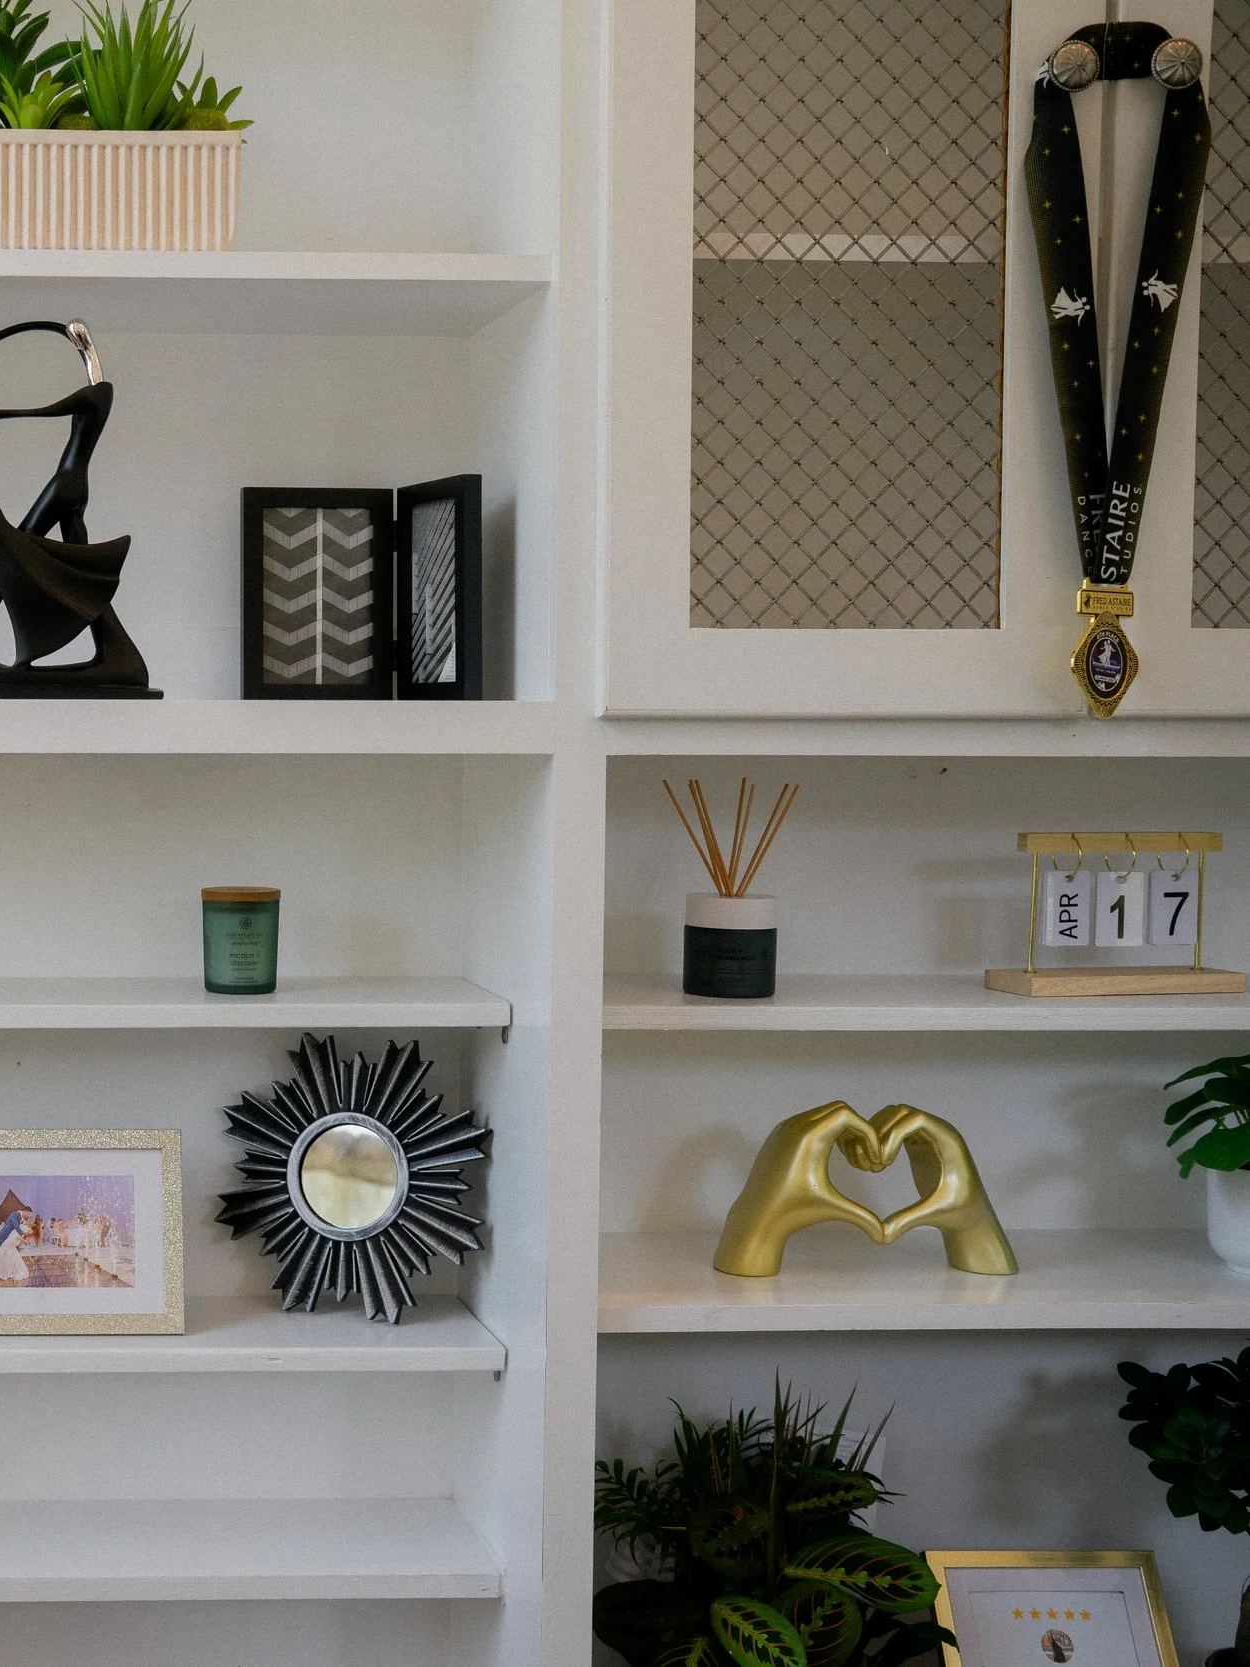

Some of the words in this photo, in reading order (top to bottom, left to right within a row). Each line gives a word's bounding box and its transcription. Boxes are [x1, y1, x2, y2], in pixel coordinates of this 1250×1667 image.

[1093, 596, 1108, 605] FRED
[1108, 597, 1131, 607] ASTAIRE
[1058, 893, 1079, 939] APR
[1109, 894, 1125, 940] 1
[1163, 891, 1190, 936] 7
